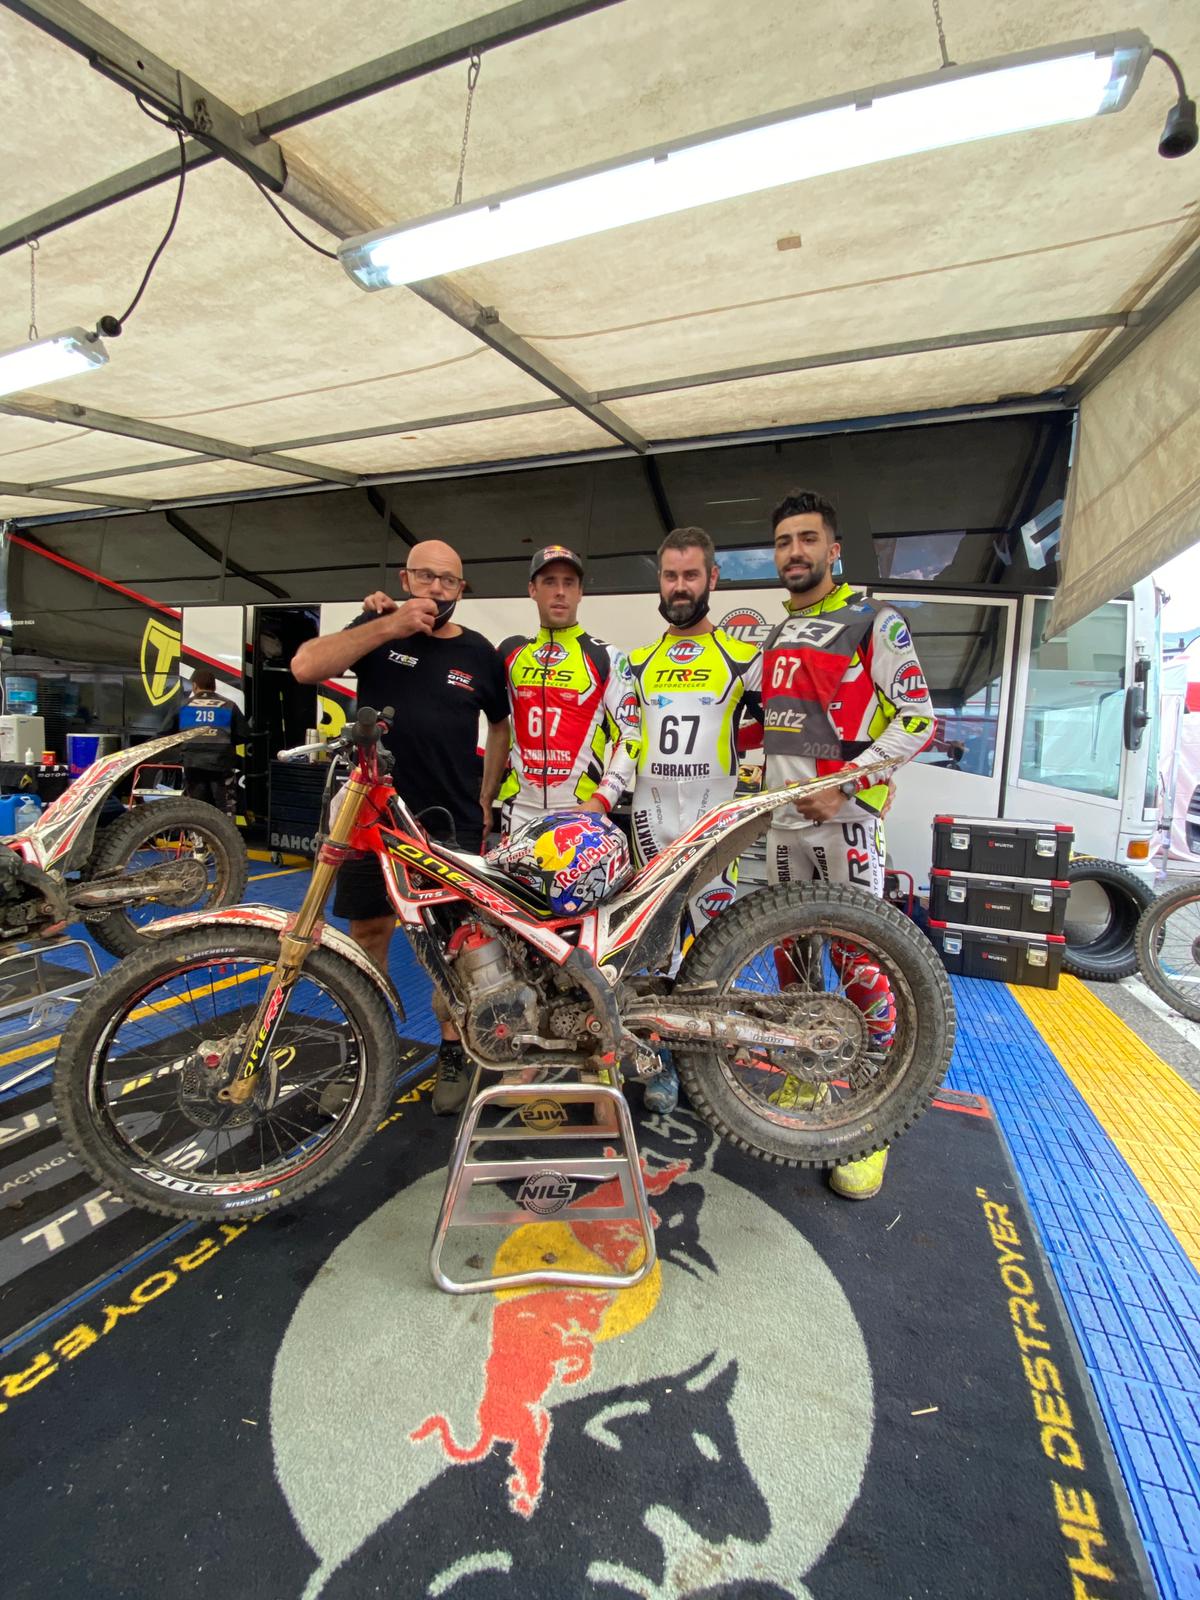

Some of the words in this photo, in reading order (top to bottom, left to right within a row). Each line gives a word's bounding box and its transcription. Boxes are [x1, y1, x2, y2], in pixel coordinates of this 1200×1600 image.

[666, 647, 705, 657] NILS
[772, 655, 801, 689] 67
[891, 675, 929, 699] NIL
[195, 710, 215, 722] 219
[528, 706, 562, 738] 67
[765, 708, 807, 728] Hertz
[660, 715, 701, 755] 67
[662, 763, 710, 777] BRAKTEC
[271, 833, 318, 850] BAHCO
[555, 852, 592, 889] Red
[584, 833, 619, 865] Bull
[193, 947, 236, 957] MICHELIN
[519, 1184, 572, 1200] NILS
